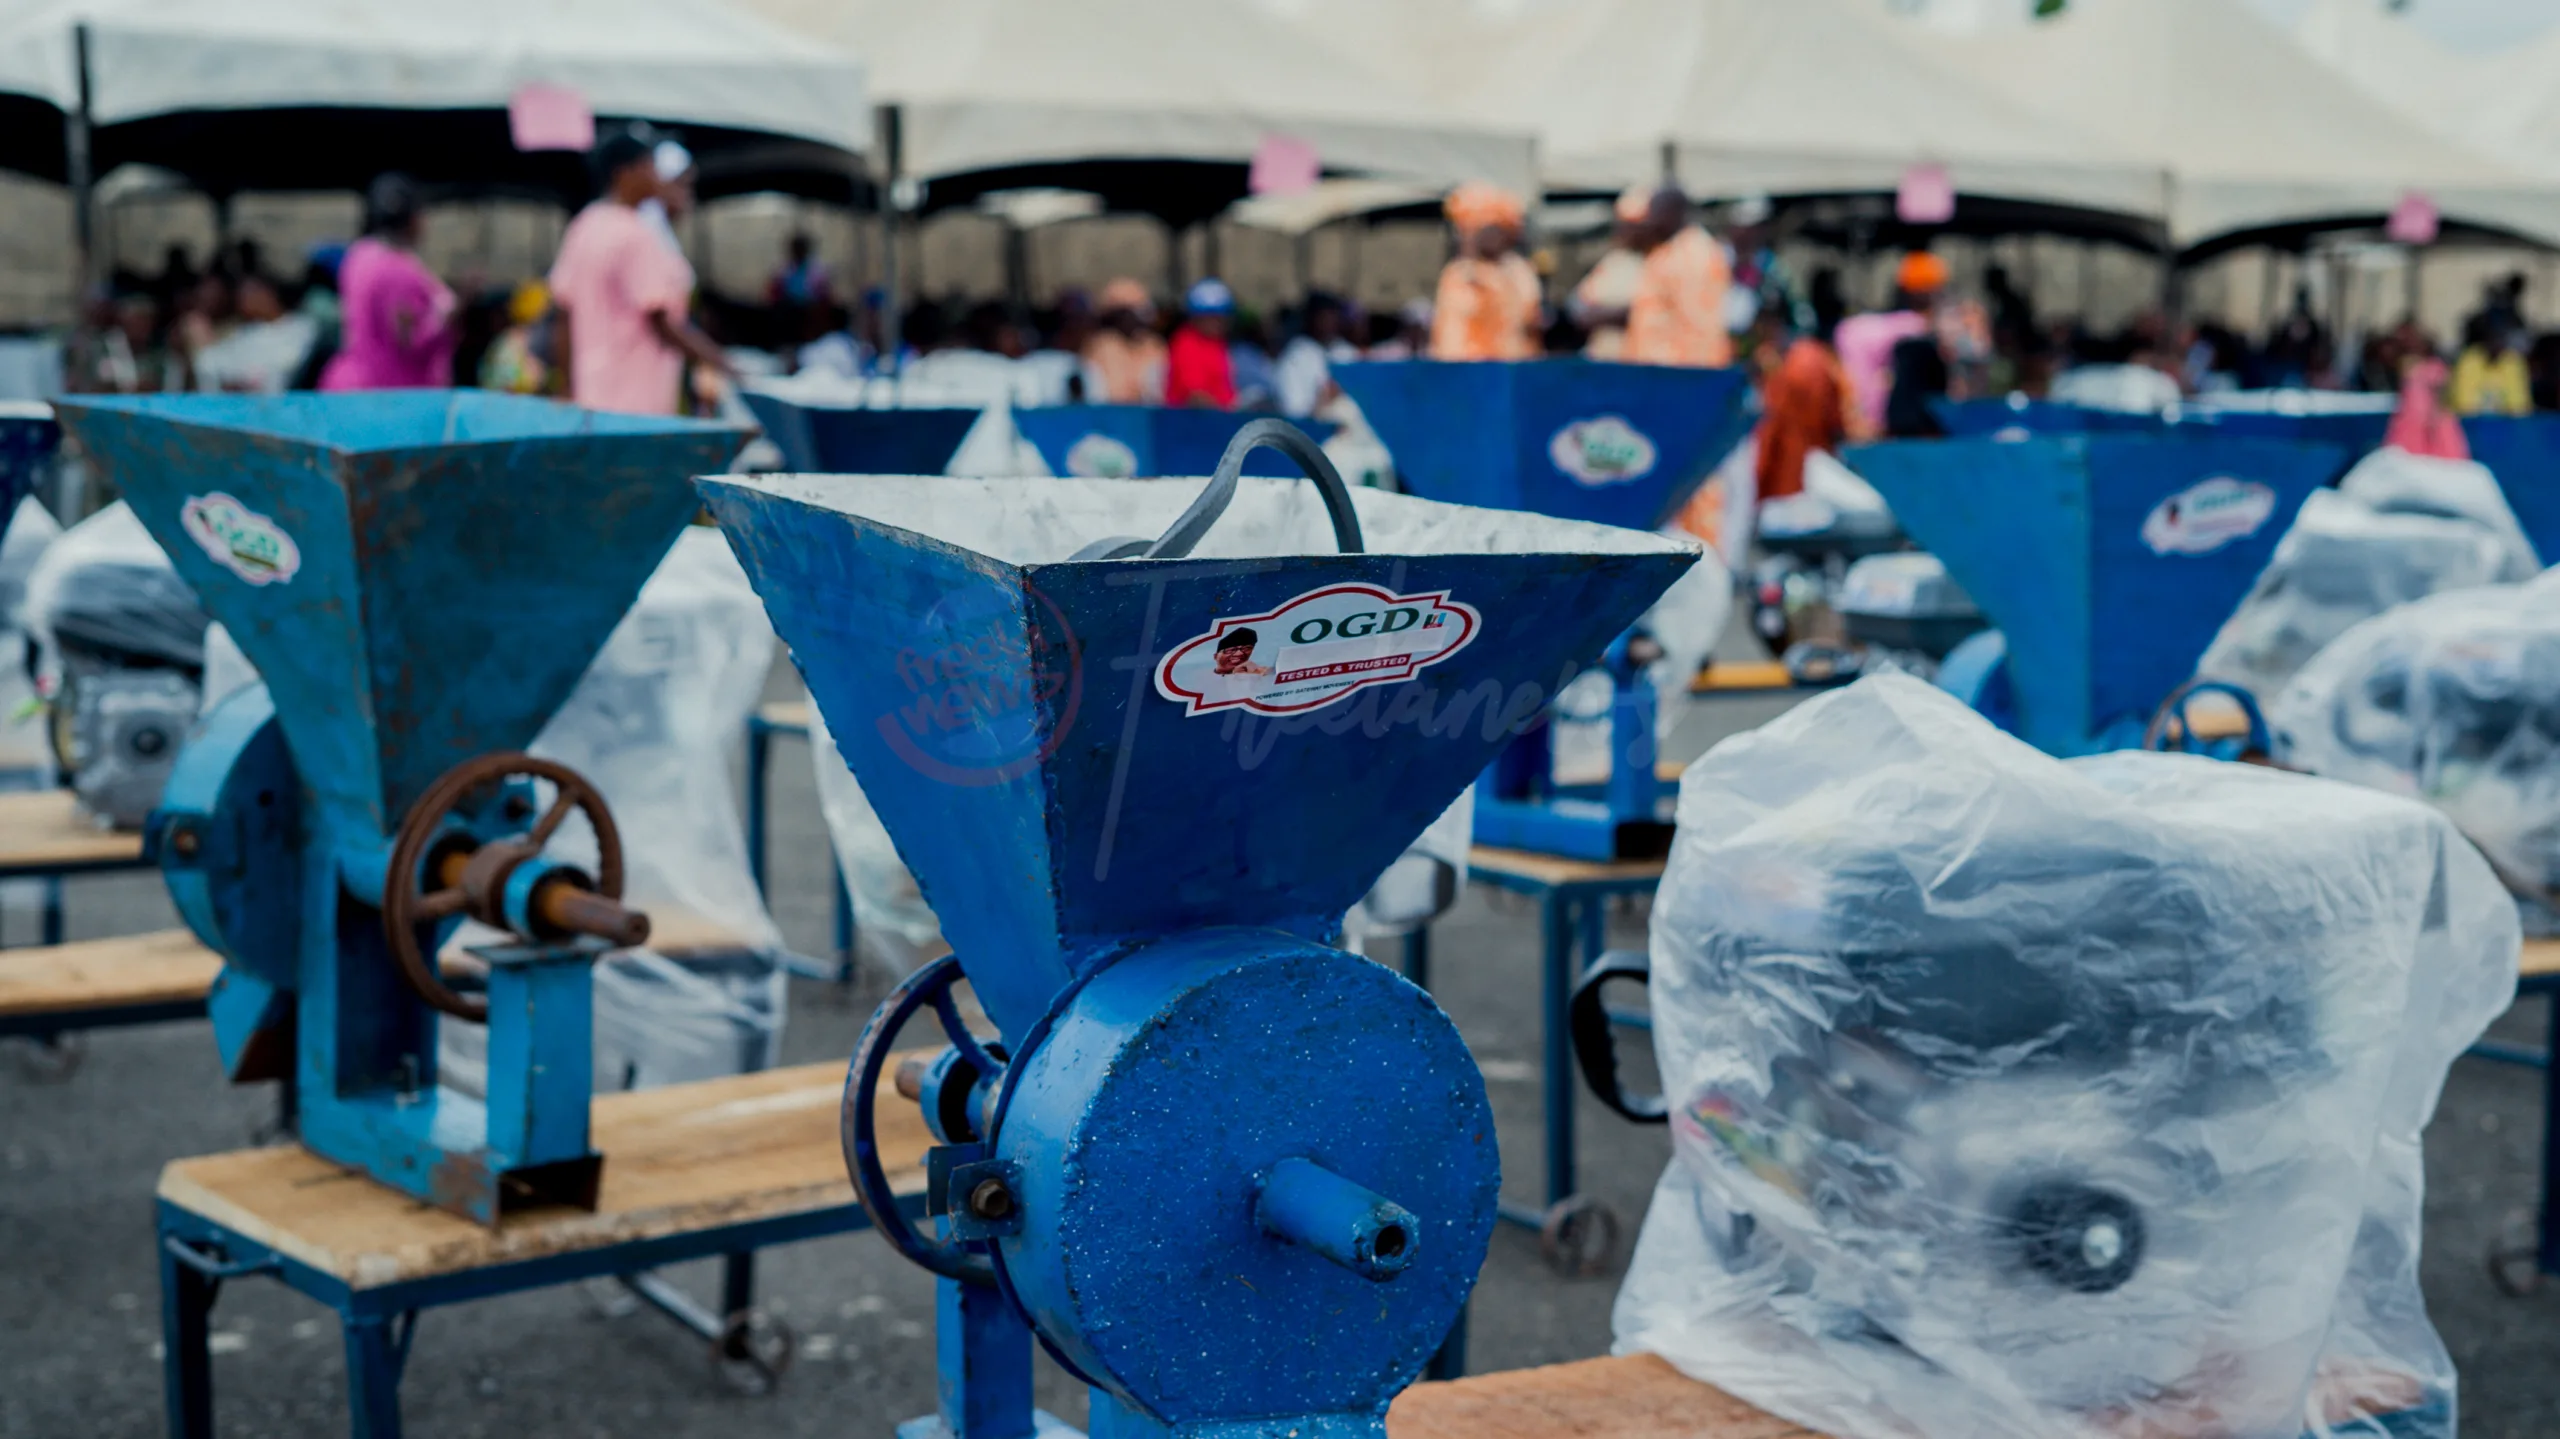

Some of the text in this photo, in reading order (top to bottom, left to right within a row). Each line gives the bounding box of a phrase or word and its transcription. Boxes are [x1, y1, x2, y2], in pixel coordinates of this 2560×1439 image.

[1290, 607, 1420, 644] OGD
[1280, 656, 1408, 682] TESTED & TRUSTED
[1255, 691, 1284, 701] POWERED
[1322, 680, 1356, 690] MOVEMENT
